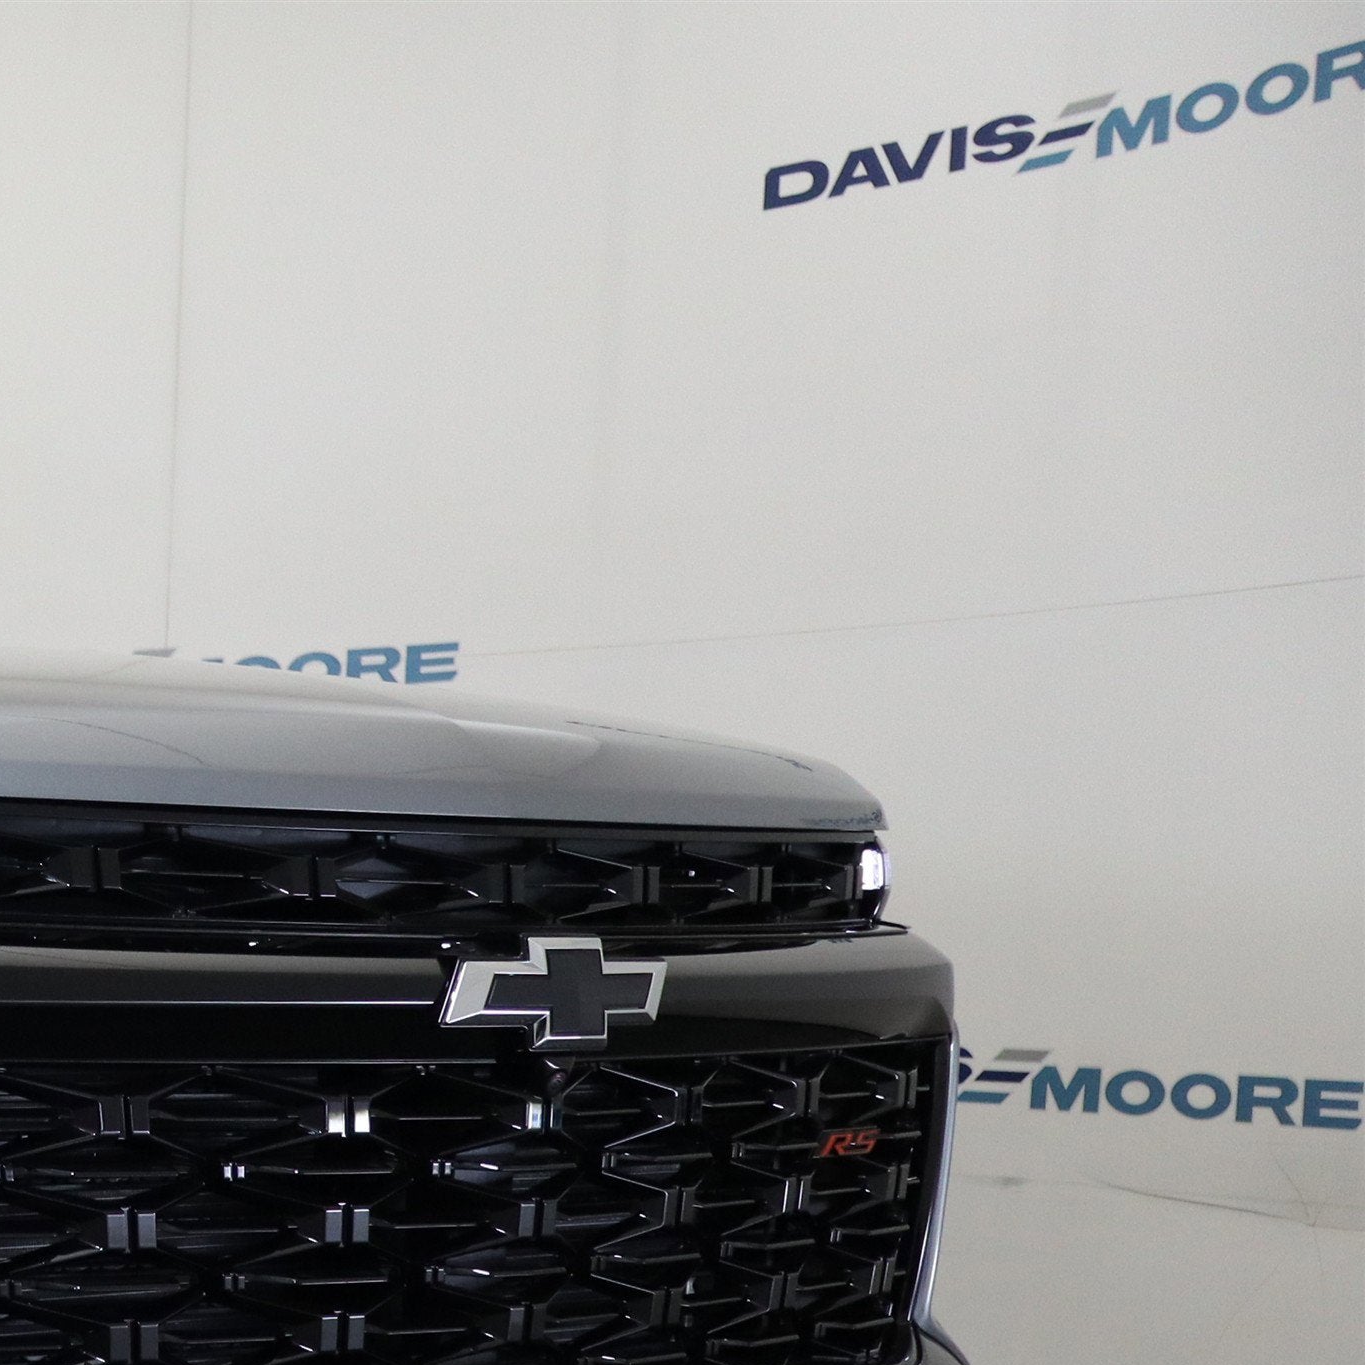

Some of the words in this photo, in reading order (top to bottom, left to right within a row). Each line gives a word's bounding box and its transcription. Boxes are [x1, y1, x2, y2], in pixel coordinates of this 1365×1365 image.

[762, 114, 1036, 211] DAVIS
[202, 641, 460, 685] ORE
[1029, 1064, 1365, 1132] MOORE
[821, 1128, 882, 1157] RS
